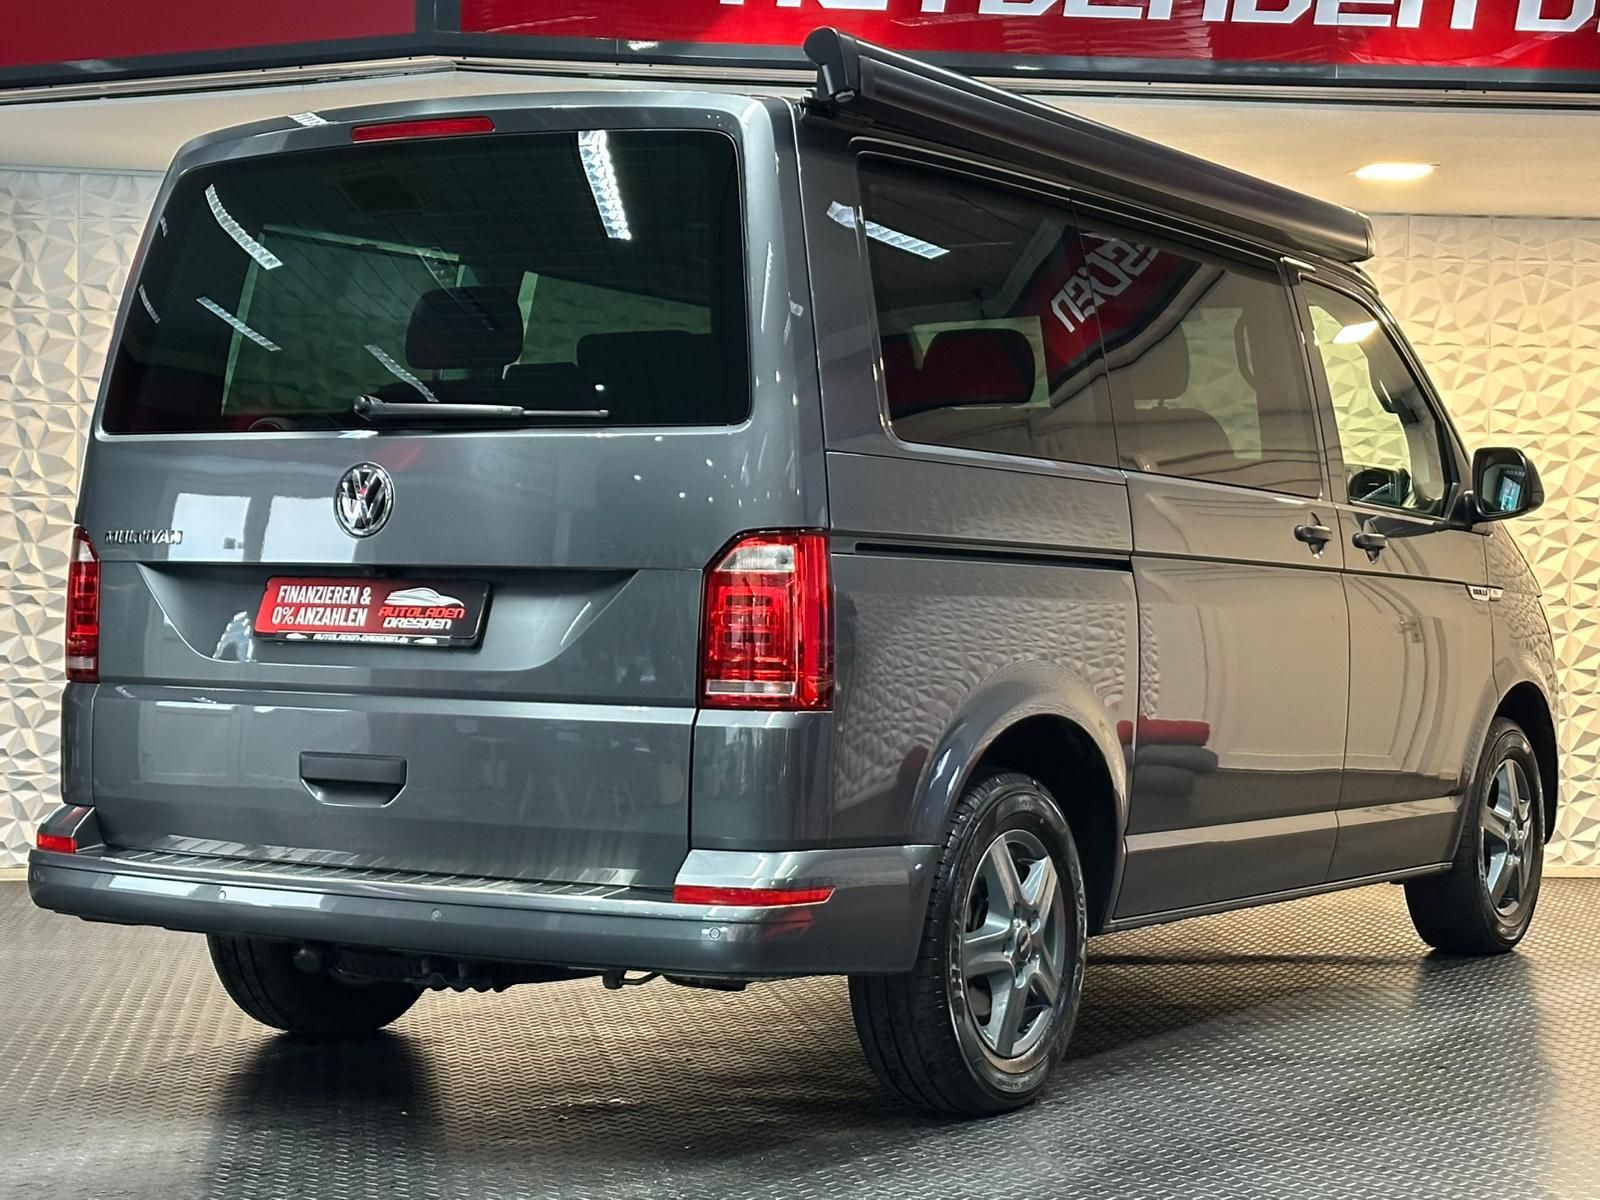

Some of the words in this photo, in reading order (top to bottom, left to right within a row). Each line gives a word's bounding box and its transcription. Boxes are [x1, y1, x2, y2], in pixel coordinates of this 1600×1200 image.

[277, 585, 360, 605] FINANZIEREN
[360, 587, 372, 606] &
[271, 606, 294, 626] 0%
[295, 607, 368, 627] ANZAHLEN
[378, 606, 464, 619] AUTOLADEN
[382, 617, 452, 630] DRESDEN
